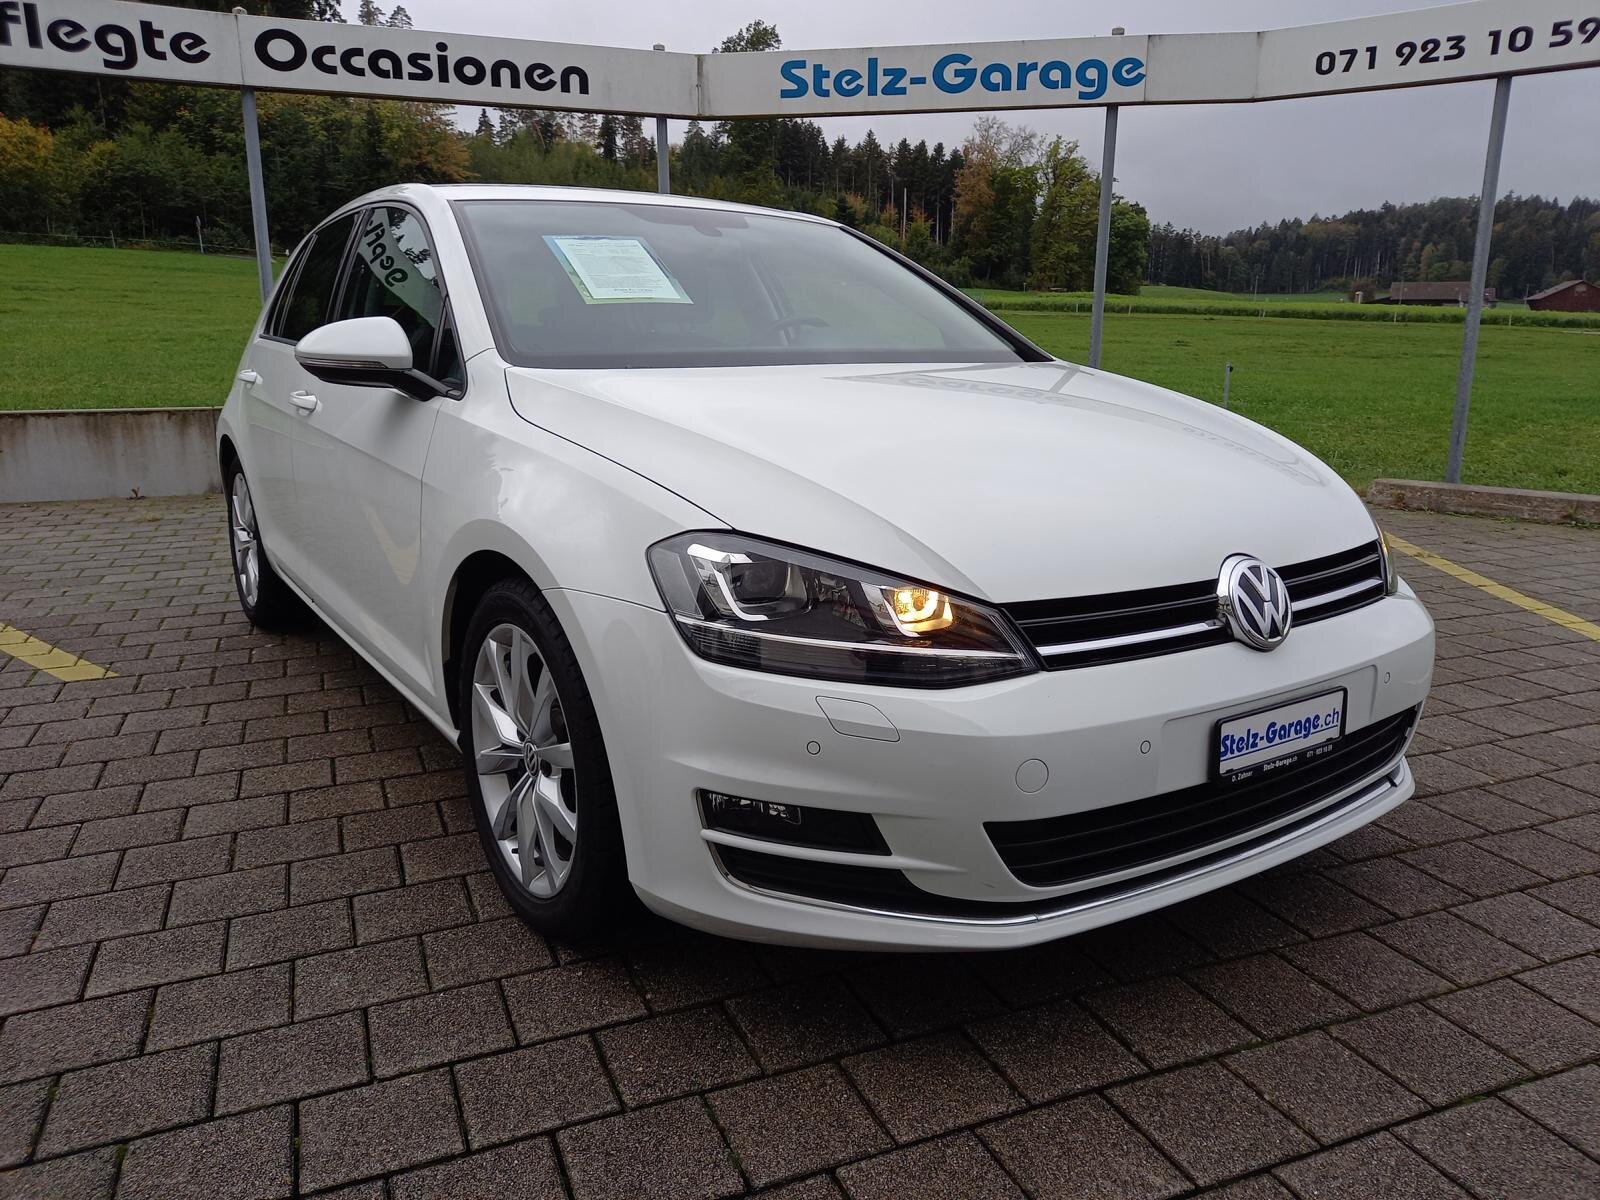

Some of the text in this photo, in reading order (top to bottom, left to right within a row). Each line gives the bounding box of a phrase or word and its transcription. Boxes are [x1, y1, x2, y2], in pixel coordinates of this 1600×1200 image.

[0, 1, 590, 95] flegte Occasionen
[1315, 17, 1600, 75] 071 923 10 59
[780, 53, 1147, 100] Stelz-Garage
[1220, 708, 1340, 758] Stelz-Garage.ch
